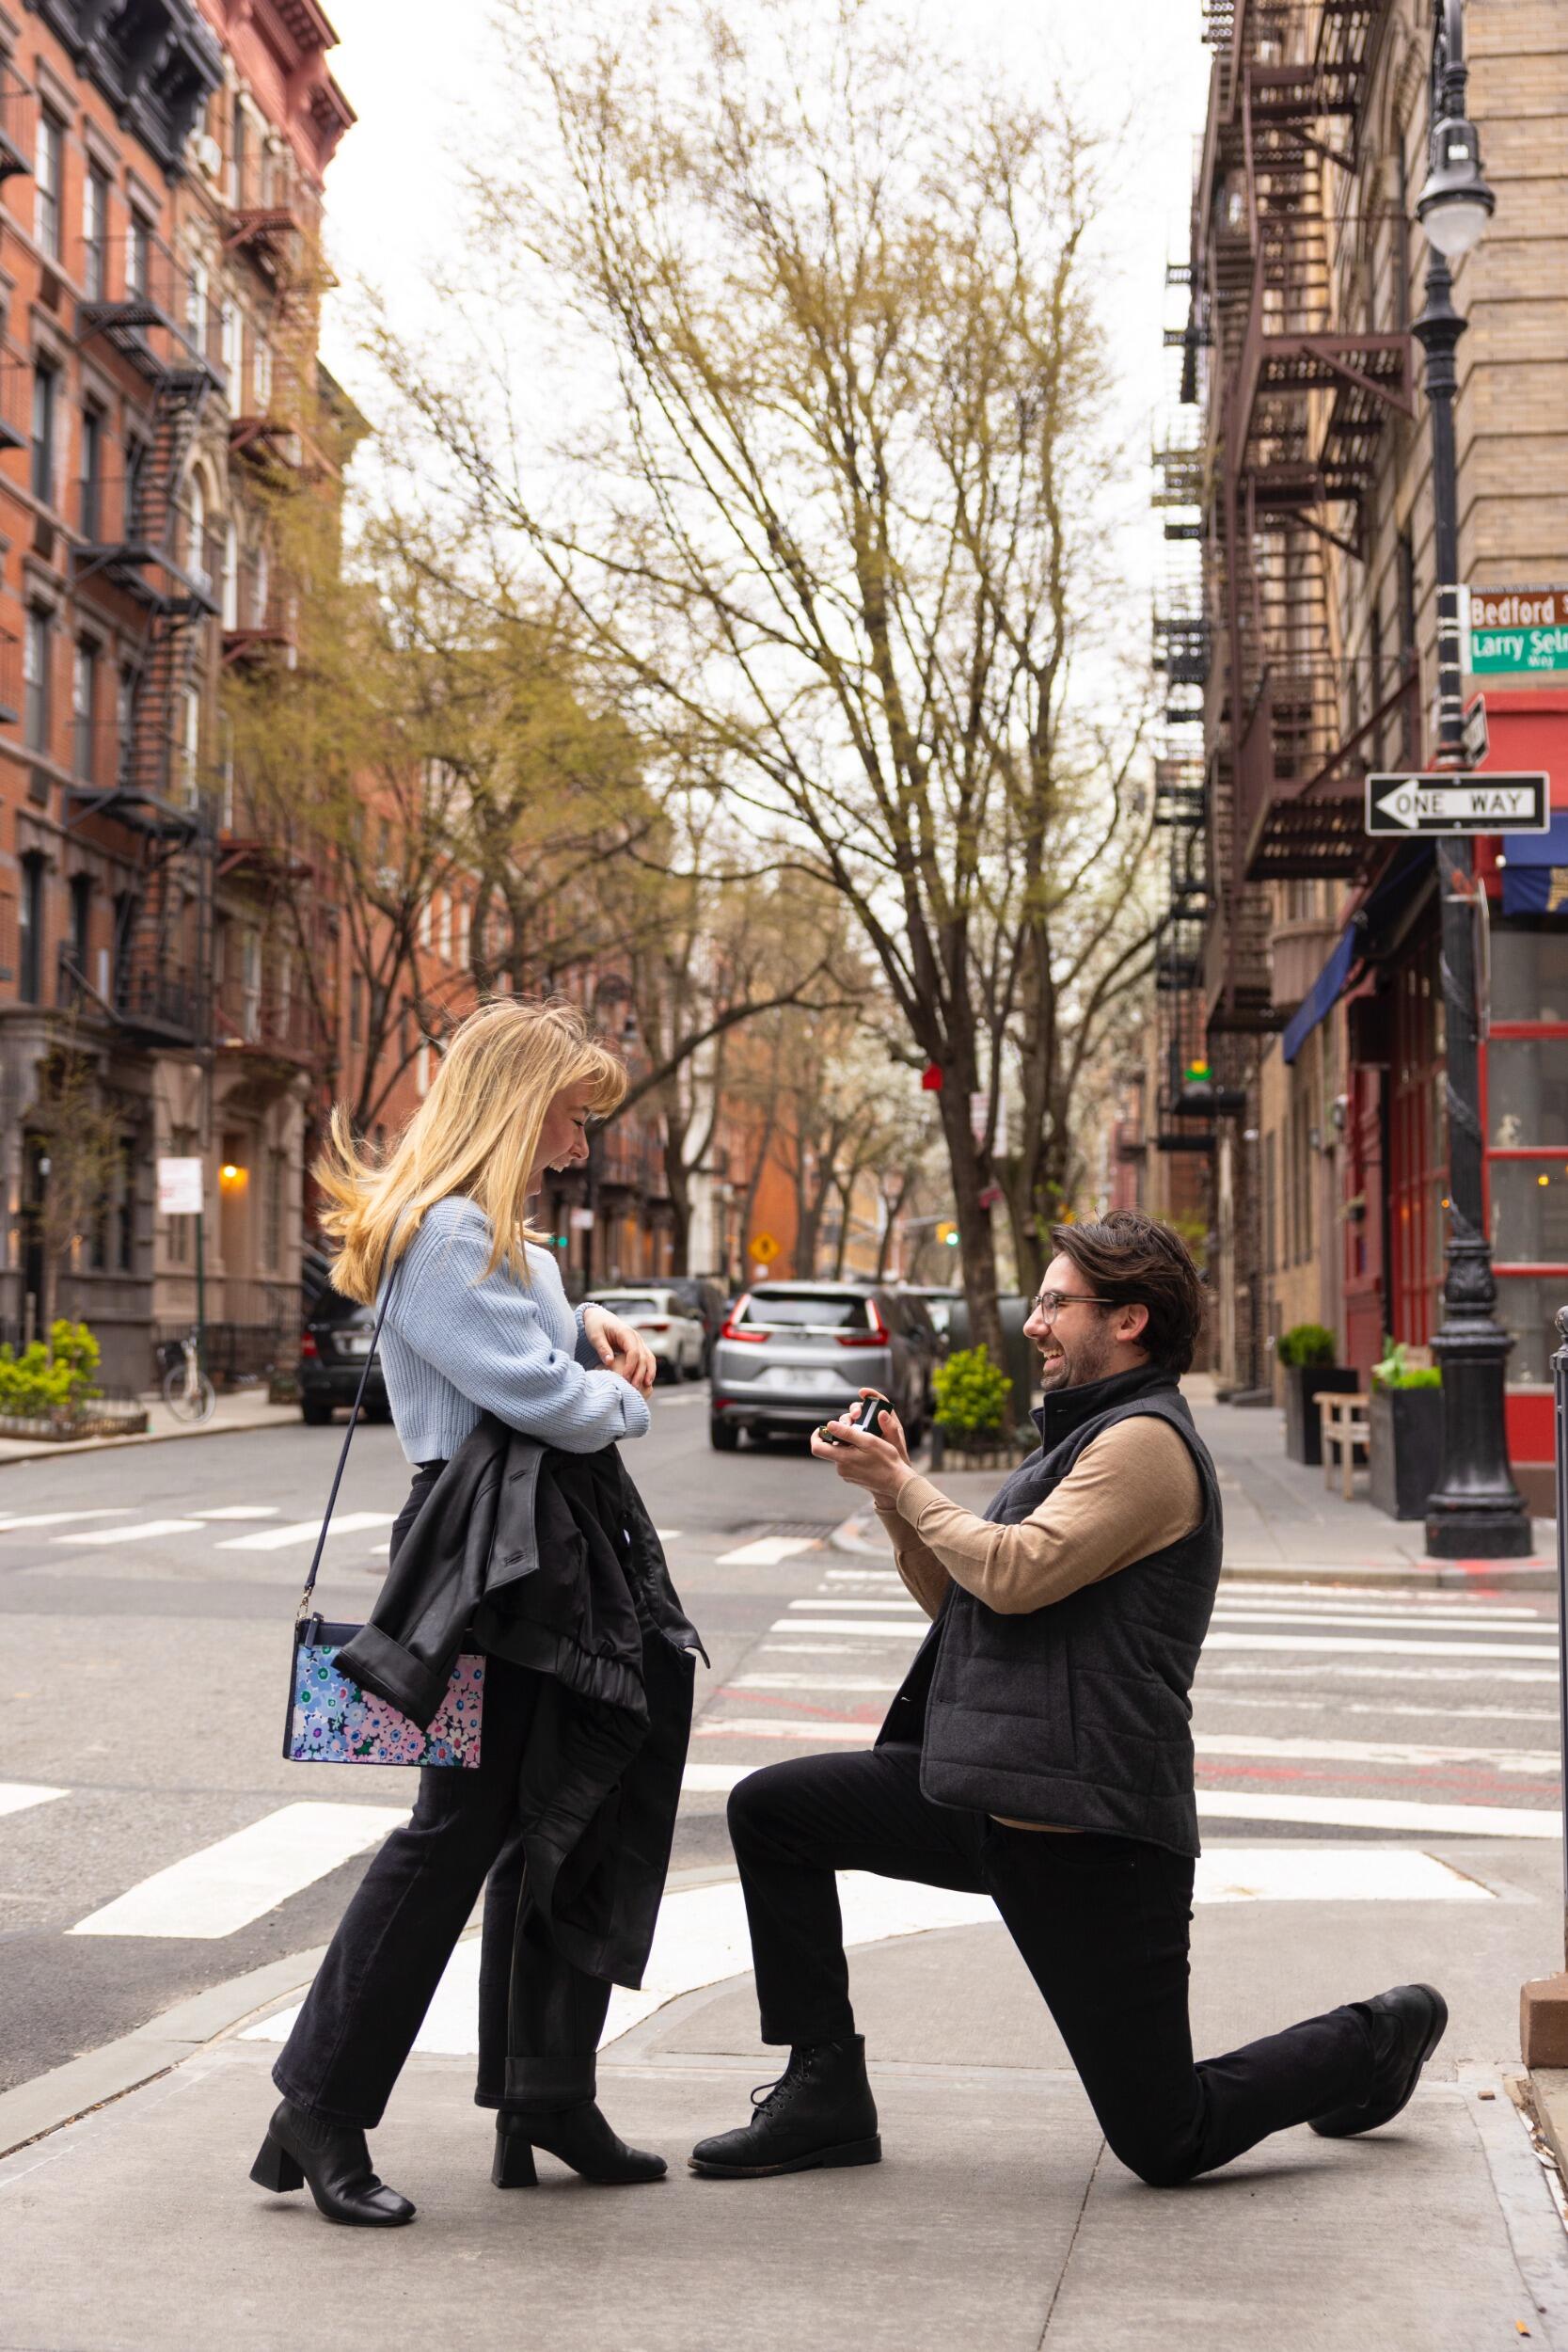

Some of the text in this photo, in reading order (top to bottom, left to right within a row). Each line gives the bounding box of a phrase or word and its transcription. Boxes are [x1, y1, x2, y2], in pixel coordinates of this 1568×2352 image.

[1471, 596, 1554, 626] Bedford
[1473, 634, 1524, 660] Larry
[1528, 655, 1554, 669] Way
[1396, 791, 1520, 815] ONE WAY
